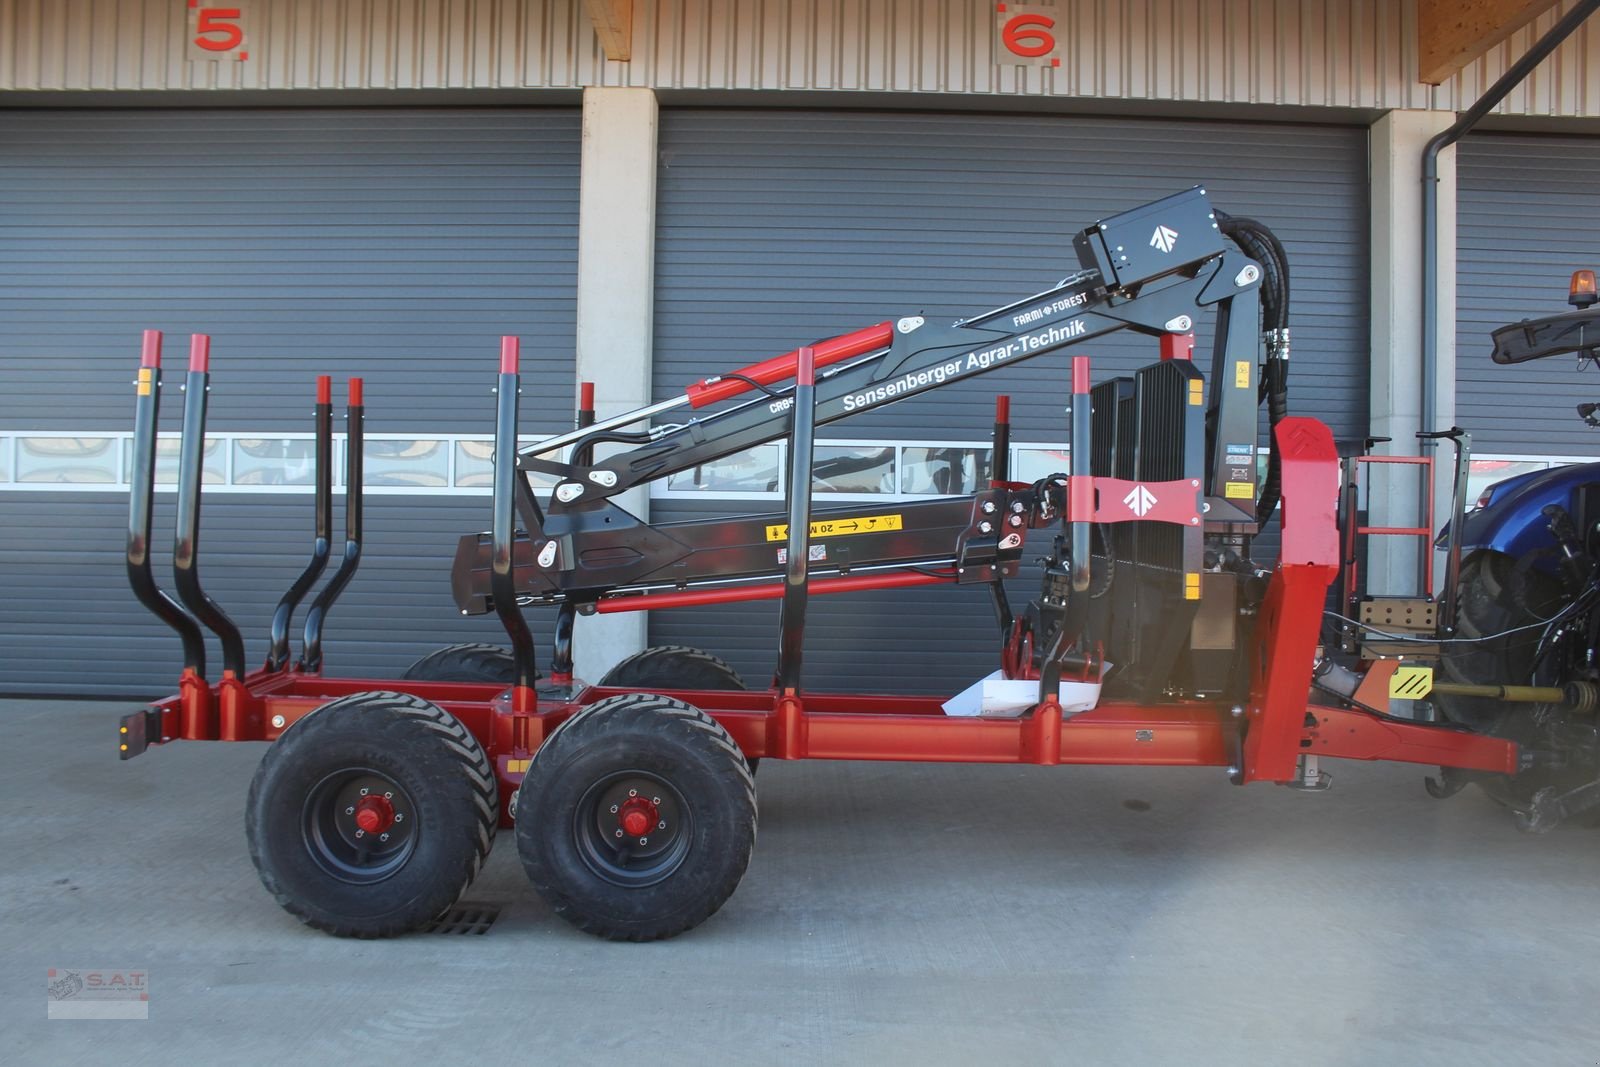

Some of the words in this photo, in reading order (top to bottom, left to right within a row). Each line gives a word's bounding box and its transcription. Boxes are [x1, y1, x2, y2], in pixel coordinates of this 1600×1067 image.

[193, 8, 243, 51] 5
[1002, 14, 1055, 57] 6
[1012, 308, 1043, 327] FARMI
[1052, 292, 1087, 313] FOREST
[843, 359, 963, 411] Sensenberger
[966, 319, 1086, 369] Agrar-Technik
[820, 524, 833, 533] 20
